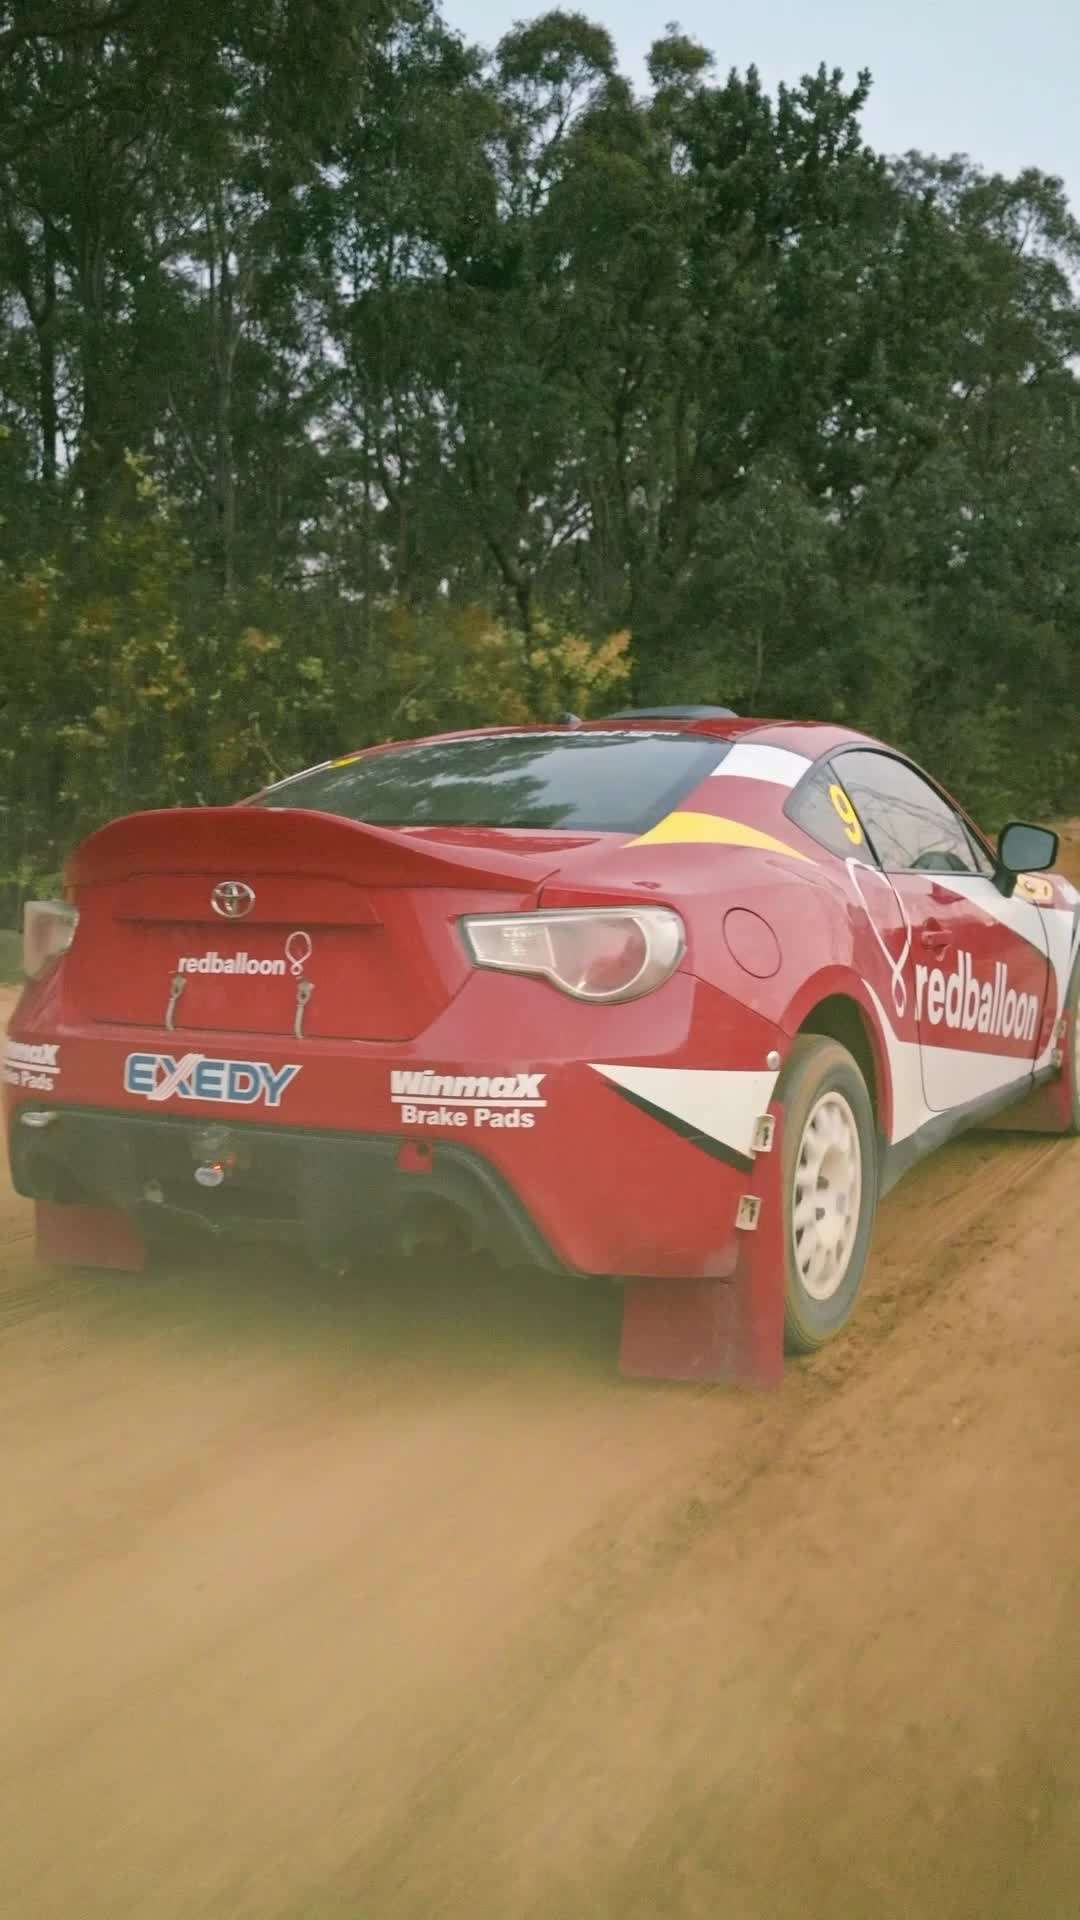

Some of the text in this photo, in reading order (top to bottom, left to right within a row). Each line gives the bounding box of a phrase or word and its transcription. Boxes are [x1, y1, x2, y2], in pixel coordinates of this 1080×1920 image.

[829, 784, 864, 845] 9
[178, 951, 286, 976] redballoon
[914, 949, 1039, 1041] redballoon
[124, 1052, 303, 1107] EXEDY
[401, 1104, 536, 1129] Brake Pads
